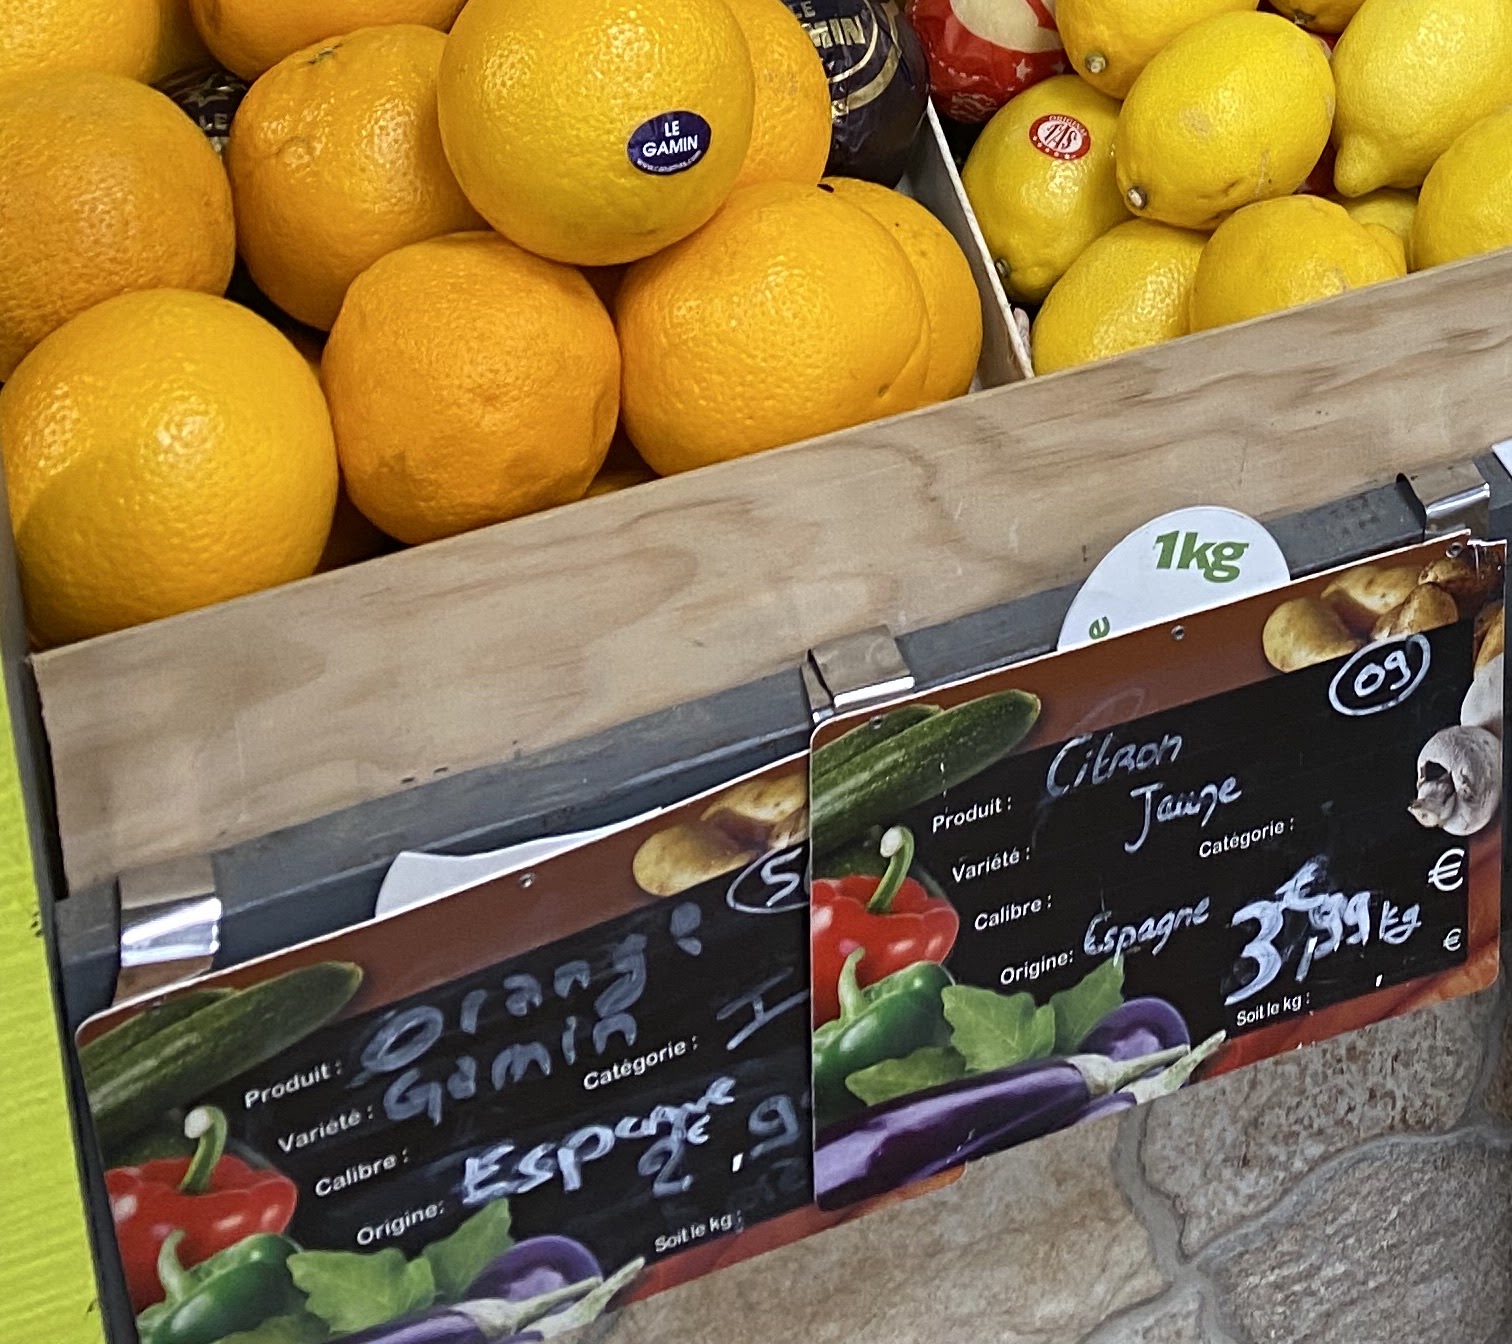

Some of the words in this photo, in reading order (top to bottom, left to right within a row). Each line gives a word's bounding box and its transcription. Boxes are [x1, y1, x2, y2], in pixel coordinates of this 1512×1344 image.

[642, 134, 698, 158] GAMIN
[664, 120, 680, 138] LE
[1044, 124, 1078, 150] TAS
[1155, 530, 1249, 584] 1kg
[932, 798, 1002, 834] Produit
[952, 849, 1021, 884] Variété
[1199, 820, 1286, 859] Catégorie
[1427, 848, 1465, 892] €
[974, 895, 1042, 931] Calibre
[1083, 896, 1210, 967] Espagne
[1378, 900, 1422, 945] kg
[1442, 928, 1462, 952] €
[1236, 1008, 1265, 1027] Soit
[1283, 995, 1302, 1011] kg
[243, 1062, 332, 1110] Produit
[584, 1041, 687, 1091] Catégorie
[277, 1105, 364, 1155] Variété
[314, 1151, 398, 1198] Calibre
[653, 1230, 689, 1253] Soit
[708, 1214, 733, 1239] kg
